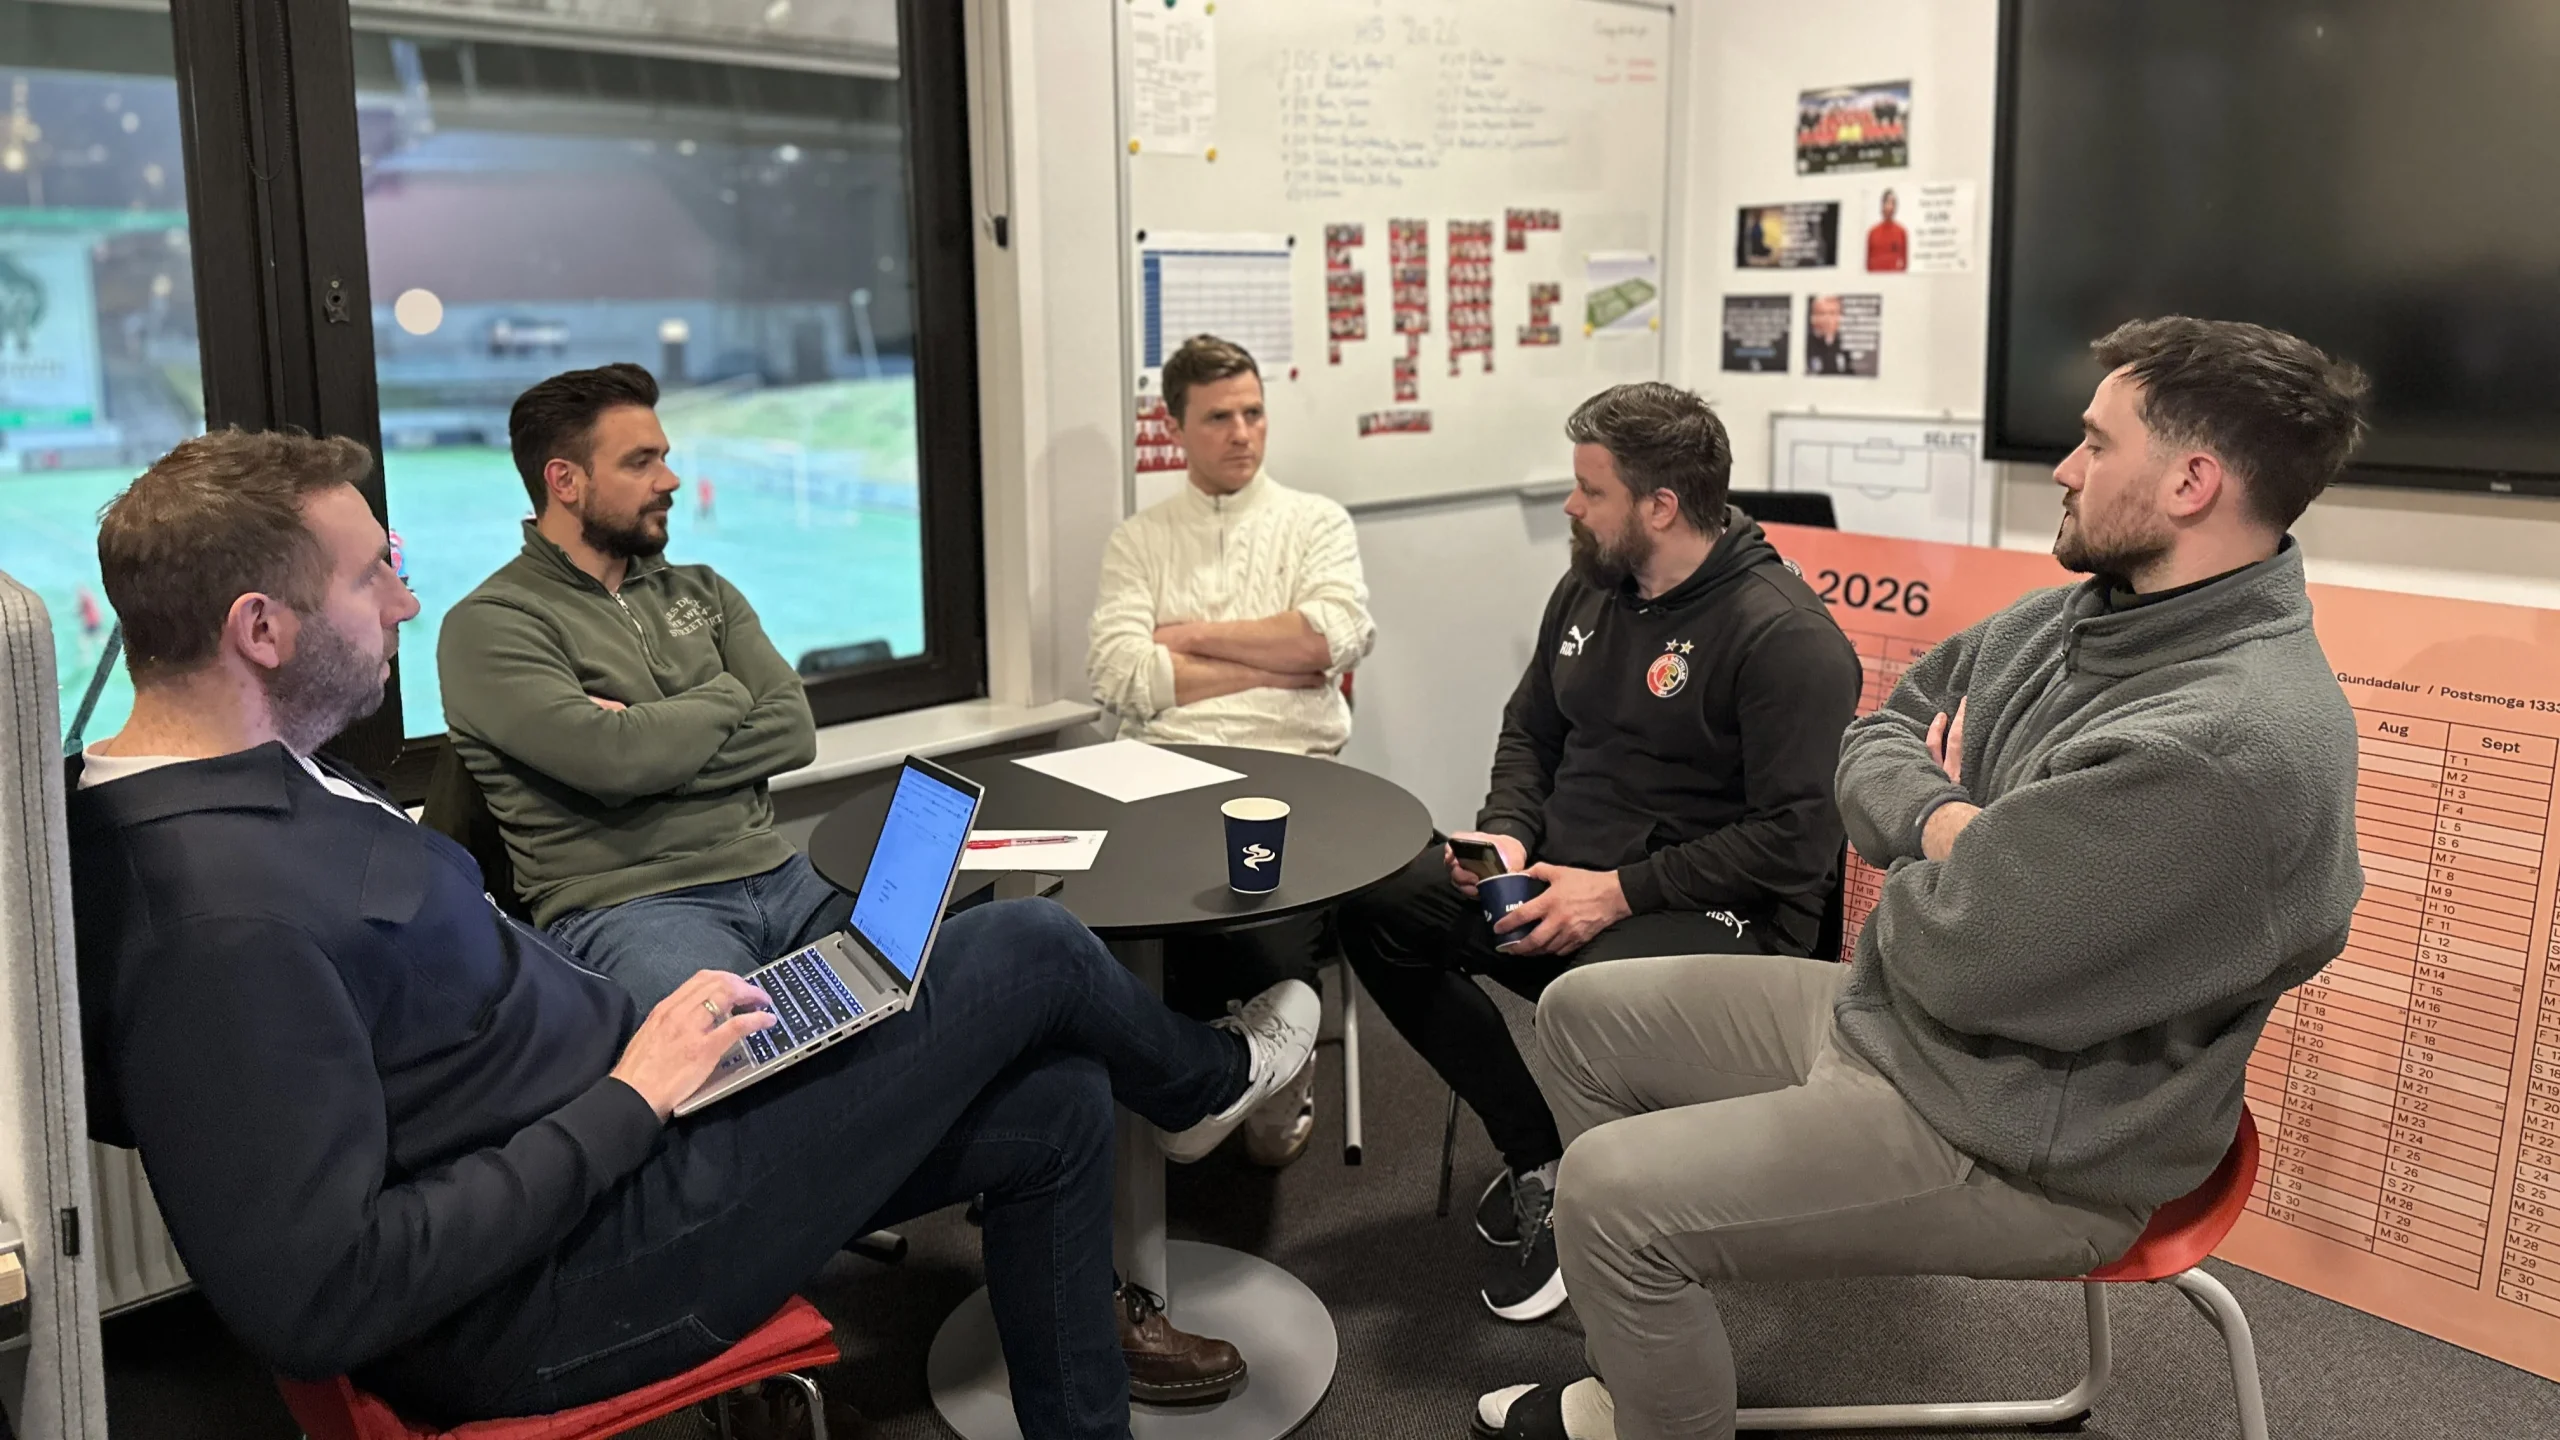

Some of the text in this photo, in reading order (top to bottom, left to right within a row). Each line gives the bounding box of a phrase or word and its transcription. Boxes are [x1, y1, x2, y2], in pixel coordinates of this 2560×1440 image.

[1817, 569, 1931, 617] 2026
[669, 618, 703, 637] STREET
[2337, 672, 2421, 693] Gundadalur
[2426, 685, 2435, 695] /
[2440, 686, 2525, 709] Postsmoga
[2377, 721, 2410, 738] Aug
[2481, 736, 2521, 754] Sept
[2449, 754, 2468, 767] T 1
[2446, 771, 2469, 784] M 2
[2444, 787, 2466, 800] H 3
[2442, 803, 2464, 816] F 4
[2439, 819, 2462, 832] L 5
[2437, 836, 2460, 849] S 6
[2435, 852, 2457, 864] M 7
[1867, 874, 1875, 882] 17
[2433, 868, 2455, 882] T 8
[1856, 884, 1874, 896] M 18
[2430, 884, 2453, 898] M 9
[1854, 898, 1873, 909] H 19
[2428, 901, 2456, 915] H 10
[2426, 917, 2450, 931] F 11
[2423, 933, 2451, 948] L 12
[2421, 949, 2448, 964] S 13
[2551, 945, 2560, 955] S
[2419, 966, 2445, 980] M 14
[2548, 961, 2560, 973] M
[2320, 975, 2331, 985] 16
[2547, 978, 2556, 989] T
[2303, 987, 2328, 1000] M 17
[2417, 982, 2443, 997] T 15
[2414, 998, 2441, 1014] M 16
[2543, 995, 2556, 1007] M
[2302, 1002, 2326, 1017] T 18
[2299, 1018, 2324, 1032] M 19
[2412, 1014, 2438, 1029] H 17
[2541, 1012, 2552, 1024] H
[2296, 1034, 2324, 1049] H 20
[2409, 1030, 2436, 1046] F 18
[2539, 1029, 2548, 1039] F
[2294, 1049, 2319, 1064] F 21
[2407, 1047, 2434, 1063] L 19
[2536, 1046, 2544, 1057] L
[2292, 1065, 2319, 1081] L 22
[2404, 1063, 2434, 1079] S 20
[2534, 1063, 2543, 1074] S
[2290, 1081, 2316, 1096] S 23
[2402, 1079, 2429, 1095] M 21
[2531, 1080, 2560, 1097] M 19
[2287, 1096, 2314, 1112] M 24
[2400, 1096, 2429, 1113] T 22
[2529, 1097, 2560, 1115] T 20
[2286, 1111, 2311, 1128] T 25
[2397, 1112, 2426, 1129] M 23
[2526, 1114, 2555, 1131] M 21
[2283, 1127, 2310, 1144] M 26
[2395, 1129, 2423, 1145] H 24
[2524, 1131, 2555, 1149] H 22
[2280, 1143, 2307, 1158] H 27
[2392, 1145, 2421, 1162] F 25
[2521, 1148, 2552, 1166] F 23
[2278, 1159, 2305, 1175] F 28
[2390, 1161, 2419, 1178] L 26
[2519, 1165, 2549, 1183] L 24
[2276, 1175, 2302, 1191] L 29
[2387, 1177, 2416, 1194] S 27
[2515, 1182, 2547, 1200] S 25
[2273, 1190, 2300, 1207] S 30
[2385, 1193, 2414, 1211] M 28
[2271, 1206, 2295, 1222] M 31
[2513, 1199, 2545, 1218] M 26
[2383, 1210, 2411, 1228] T 29
[2512, 1216, 2541, 1234] T 27
[2380, 1226, 2409, 1244] M 30
[2508, 1233, 2539, 1252] M 28
[2505, 1250, 2537, 1269] H 29
[2503, 1267, 2535, 1287] F 30
[2500, 1285, 2529, 1303] L 31
